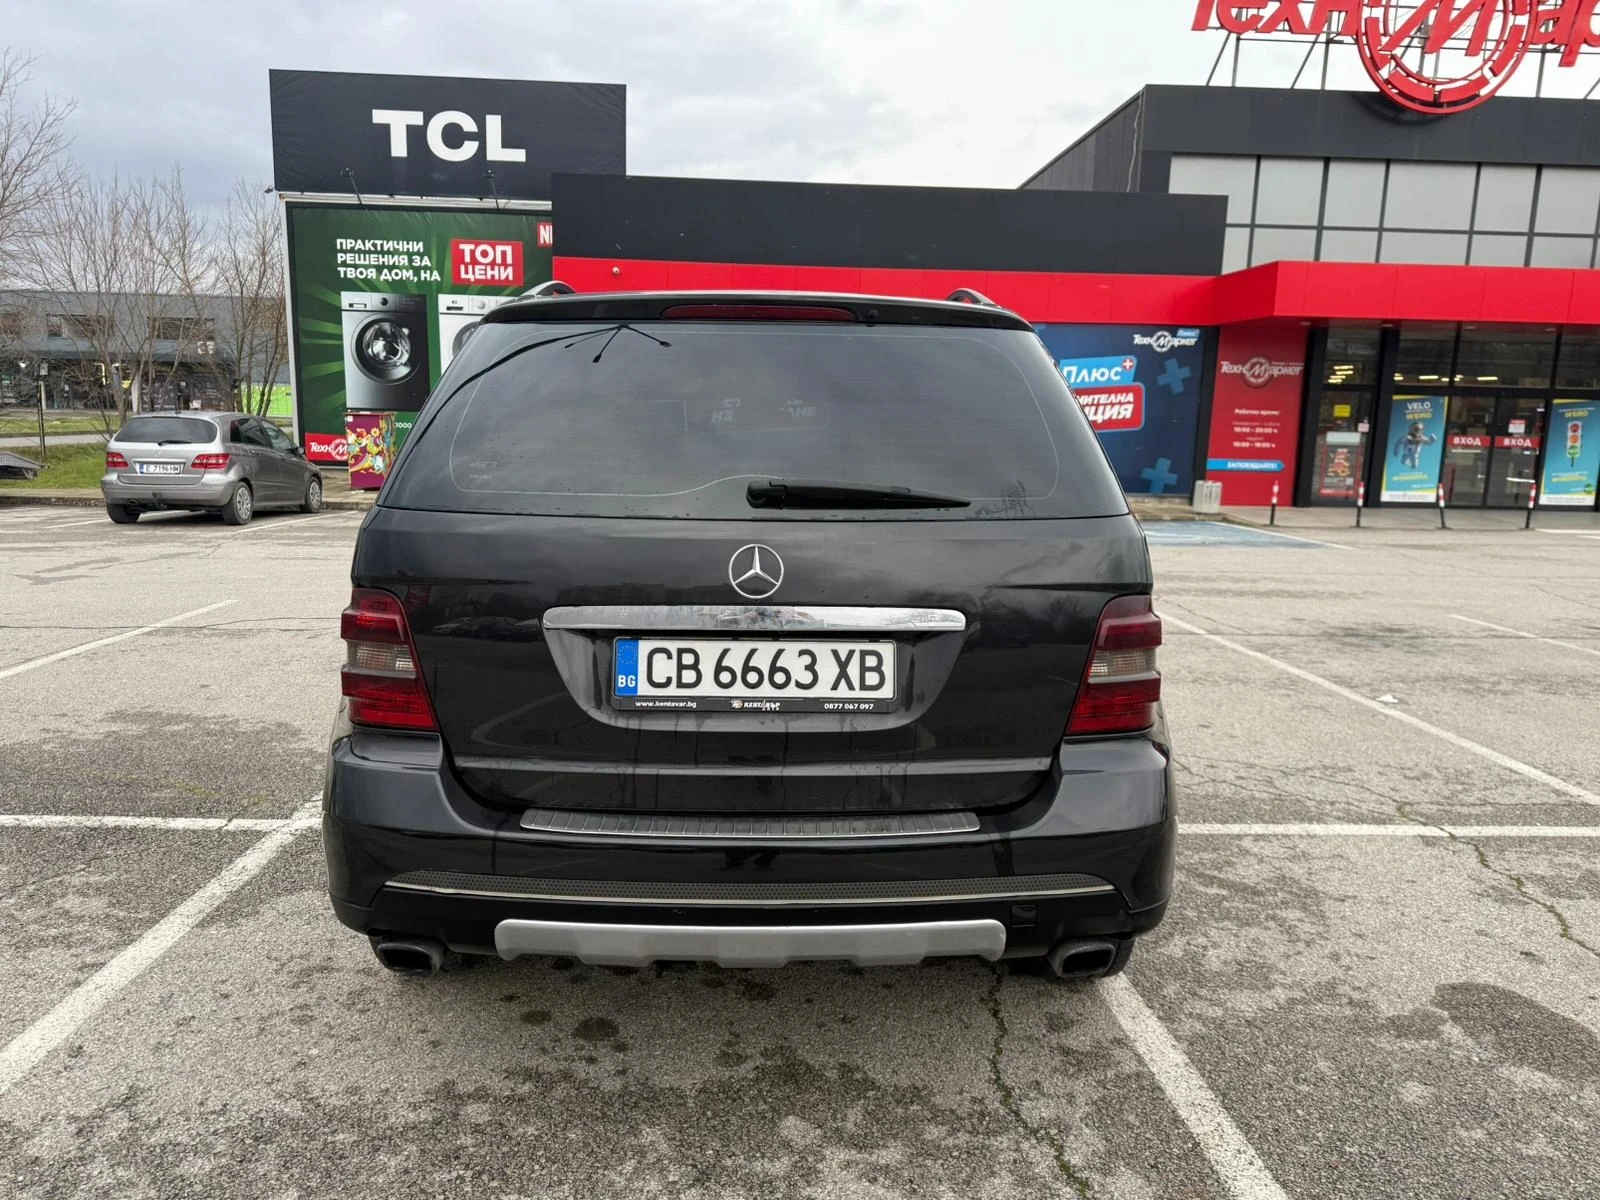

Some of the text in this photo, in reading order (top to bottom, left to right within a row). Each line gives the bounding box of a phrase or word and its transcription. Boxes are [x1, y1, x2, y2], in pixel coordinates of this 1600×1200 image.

[372, 109, 526, 162] TCL
[336, 238, 424, 253] ПРАКТИЧНИ
[337, 252, 432, 267] РЕШЕНИЯ ЗА
[459, 243, 513, 265] ТОП
[337, 266, 441, 283] ТВОЯ ДОМ, НА
[460, 264, 514, 282] ЦЕНИ
[1406, 401, 1431, 411] VELO
[1453, 437, 1482, 446] ВХОД
[1503, 438, 1533, 448] ВХОД
[646, 647, 886, 691] CB 6663 XB
[617, 675, 636, 688] BG
[635, 701, 697, 709] www.kentavar.bg
[824, 702, 843, 710] 0877
